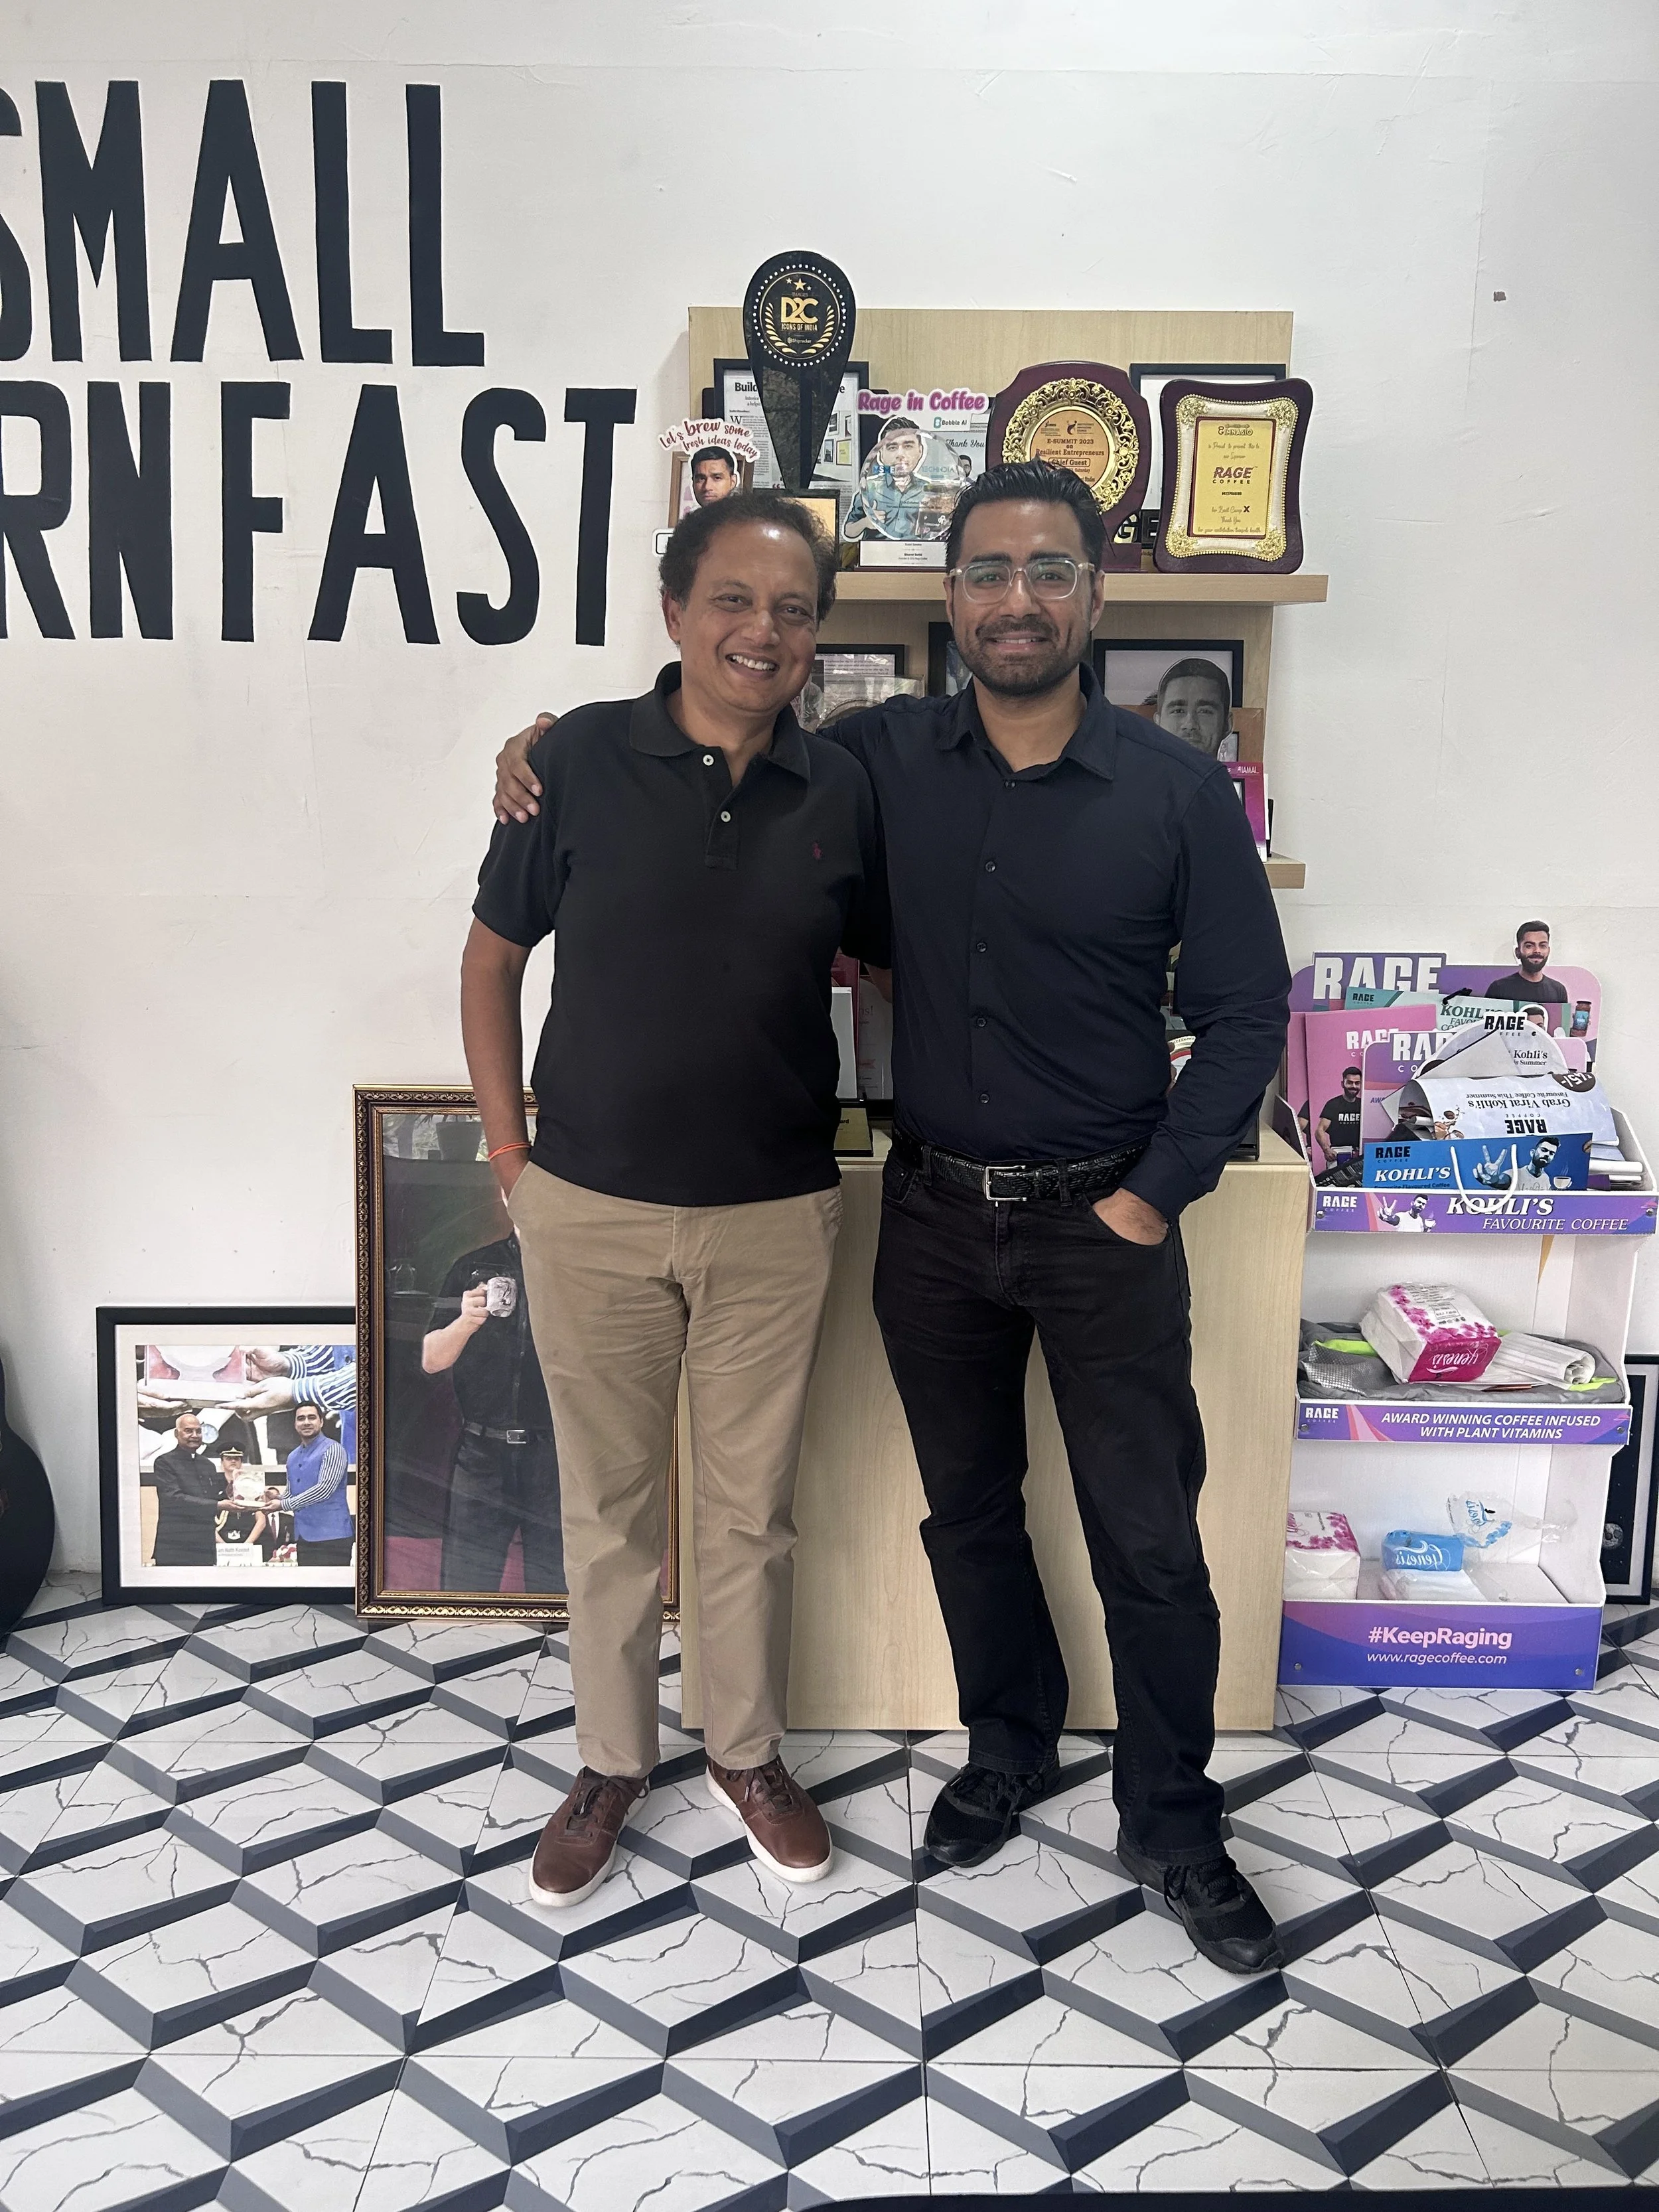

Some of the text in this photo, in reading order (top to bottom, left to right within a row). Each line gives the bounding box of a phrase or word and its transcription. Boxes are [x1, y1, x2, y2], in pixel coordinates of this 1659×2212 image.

[781, 297, 819, 324] D2C
[858, 390, 986, 415] Rage in Coffee
[660, 428, 684, 448] Let's
[684, 421, 721, 436] brew
[724, 425, 751, 437] some
[683, 436, 705, 451] fresh
[707, 435, 733, 448] ideas
[733, 438, 758, 459] today
[946, 439, 985, 449] Thank You
[873, 465, 896, 474] MSME
[1214, 465, 1255, 479] RAGE
[222, 382, 637, 646] FAST
[1313, 957, 1442, 999] RAGE
[1352, 993, 1374, 1002] RAGE
[1440, 1003, 1503, 1019] KOHL
[1484, 1015, 1525, 1030] RAGE
[1514, 1050, 1548, 1059] Kohli's
[1469, 1098, 1571, 1109] Grab Virat Kohli's
[1504, 1119, 1548, 1134] RAGE
[1375, 1146, 1411, 1159] RAGE
[1374, 1167, 1451, 1182] KOHLI'S
[1323, 1195, 1358, 1208] RAGE
[1482, 1218, 1628, 1230] FAVOURITE COFFEE
[1305, 1408, 1339, 1419] RAGE
[1381, 1412, 1601, 1426] AWARD WINNING COFFEE INFUSED
[1420, 1426, 1563, 1439] WITH PLANT VITAMINS
[1368, 1627, 1512, 1649] #KeepRaging
[1367, 1652, 1507, 1665] www.ragecoffee.com
